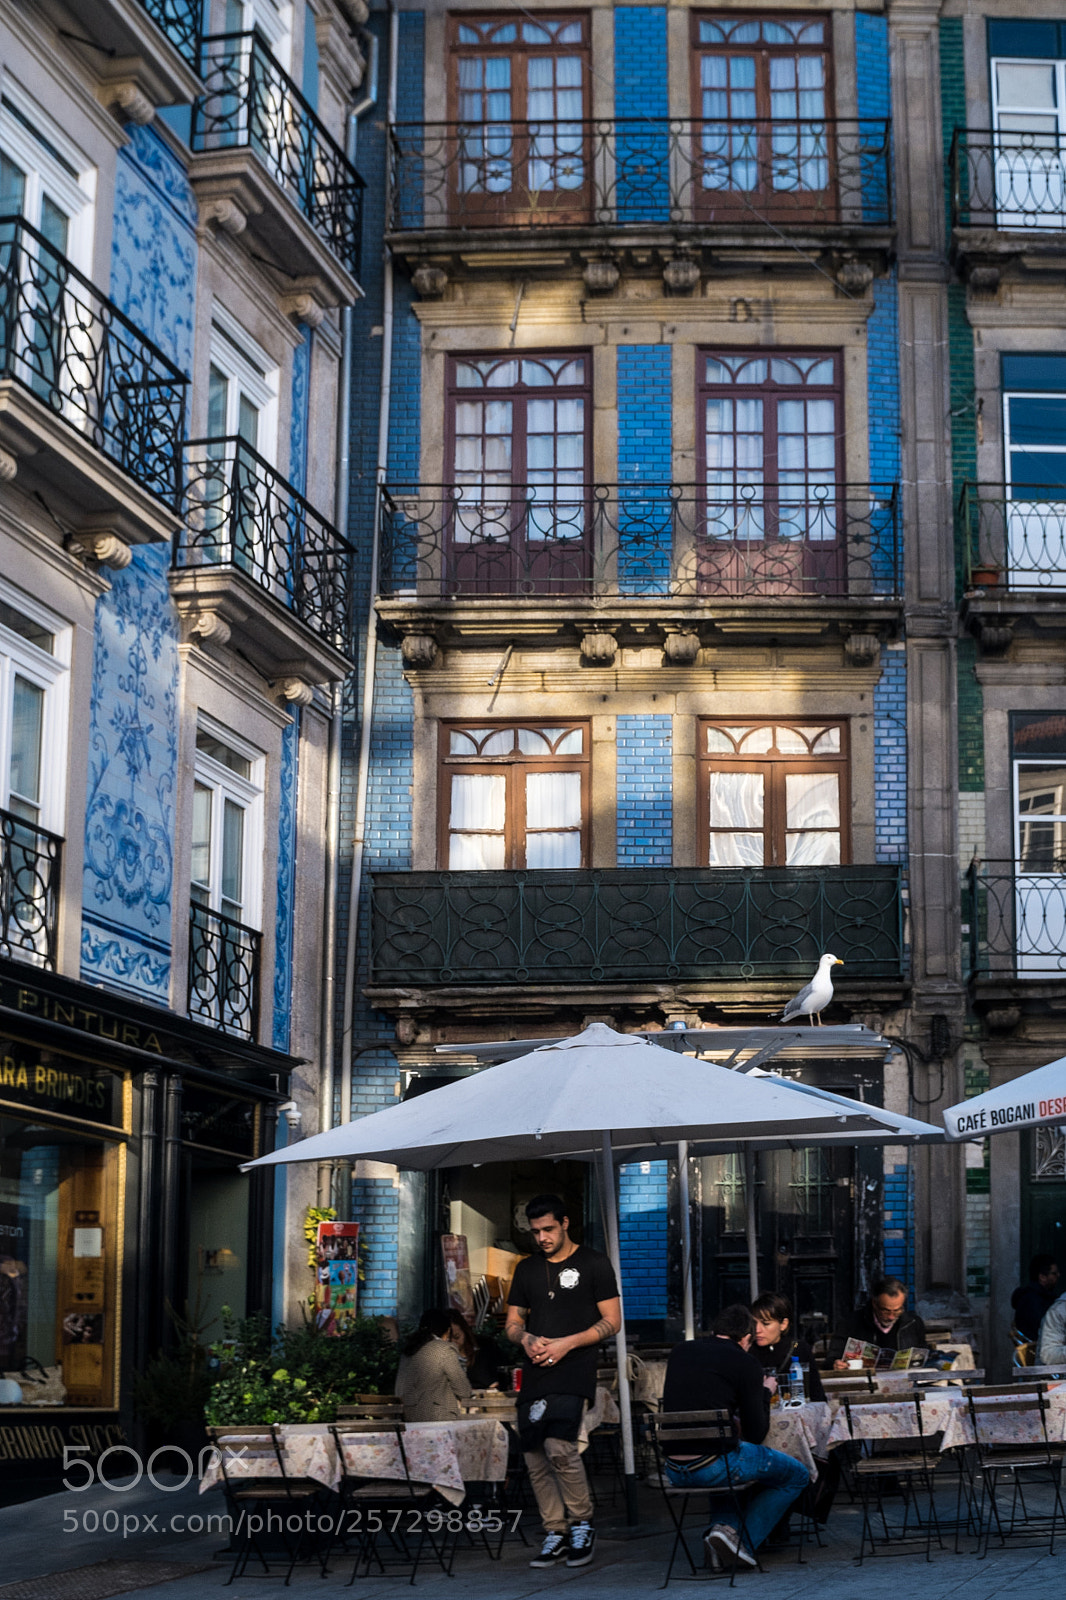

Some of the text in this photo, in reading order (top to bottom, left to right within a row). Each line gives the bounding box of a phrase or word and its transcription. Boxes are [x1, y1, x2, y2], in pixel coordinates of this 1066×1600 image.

[17, 988, 163, 1054] PINTURA
[34, 1063, 106, 1109] BRINDES
[957, 1108, 987, 1133] CAFÉ
[990, 1102, 1035, 1126] BOGANI
